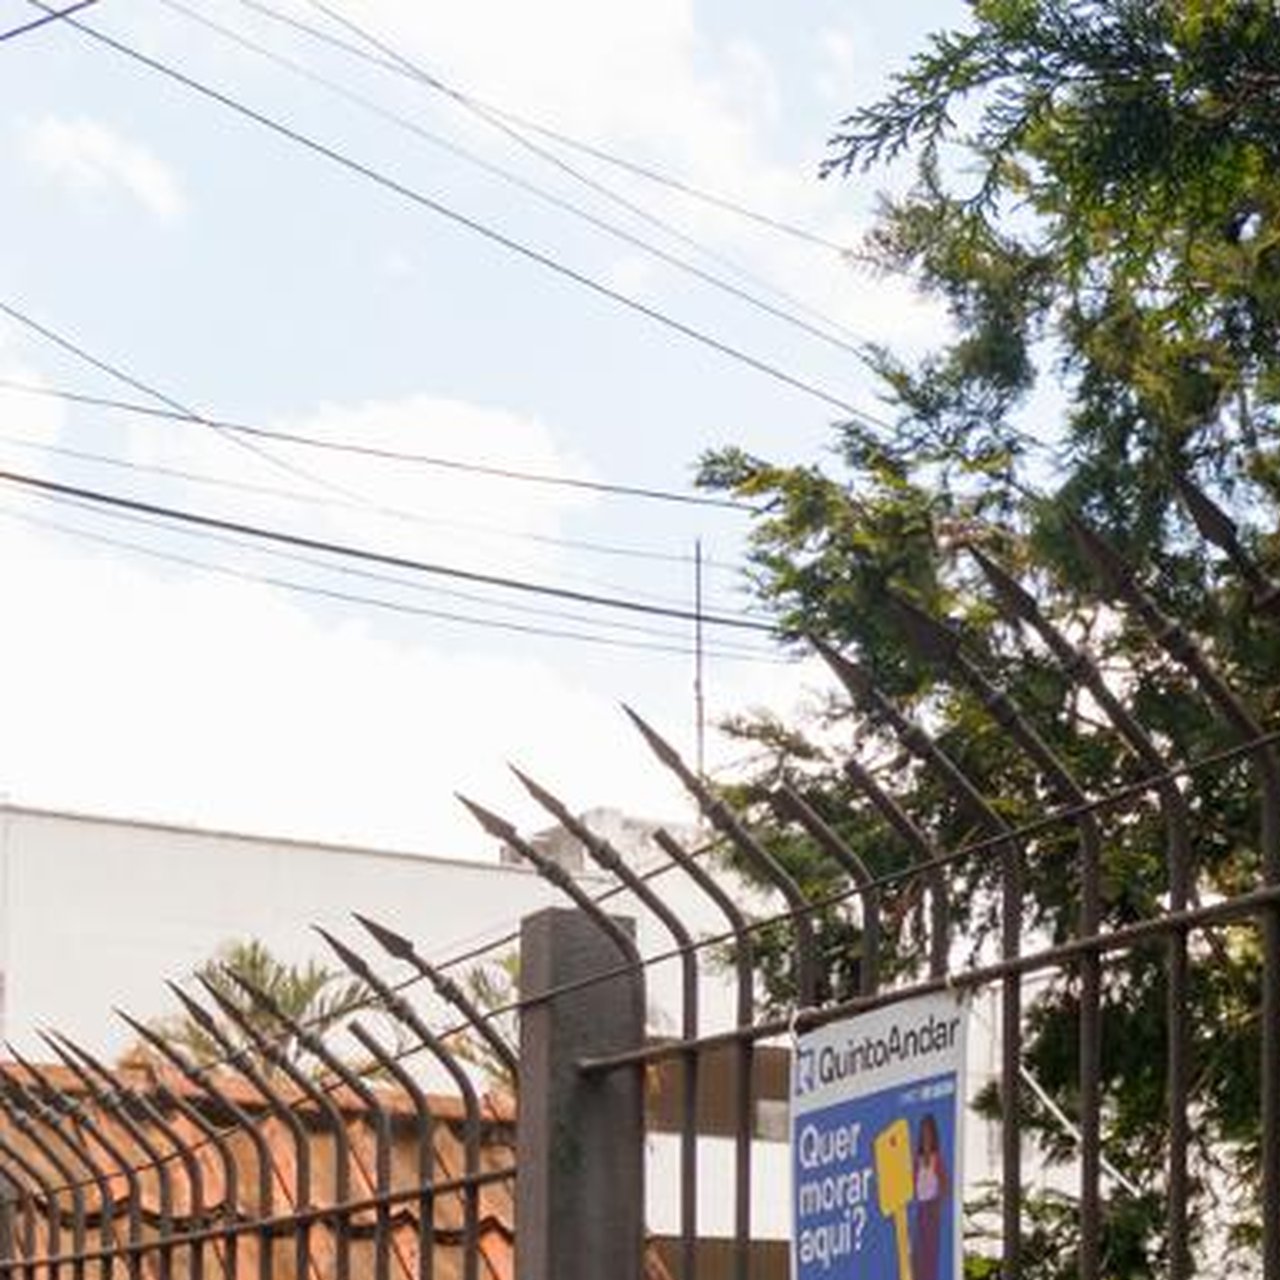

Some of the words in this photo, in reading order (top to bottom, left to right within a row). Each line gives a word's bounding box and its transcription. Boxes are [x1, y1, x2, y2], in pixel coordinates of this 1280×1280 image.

[819, 1014, 961, 1084] QuintoAndar
[800, 1121, 861, 1169] Quer
[800, 1168, 873, 1217] morar
[800, 1205, 867, 1270] aqui?
